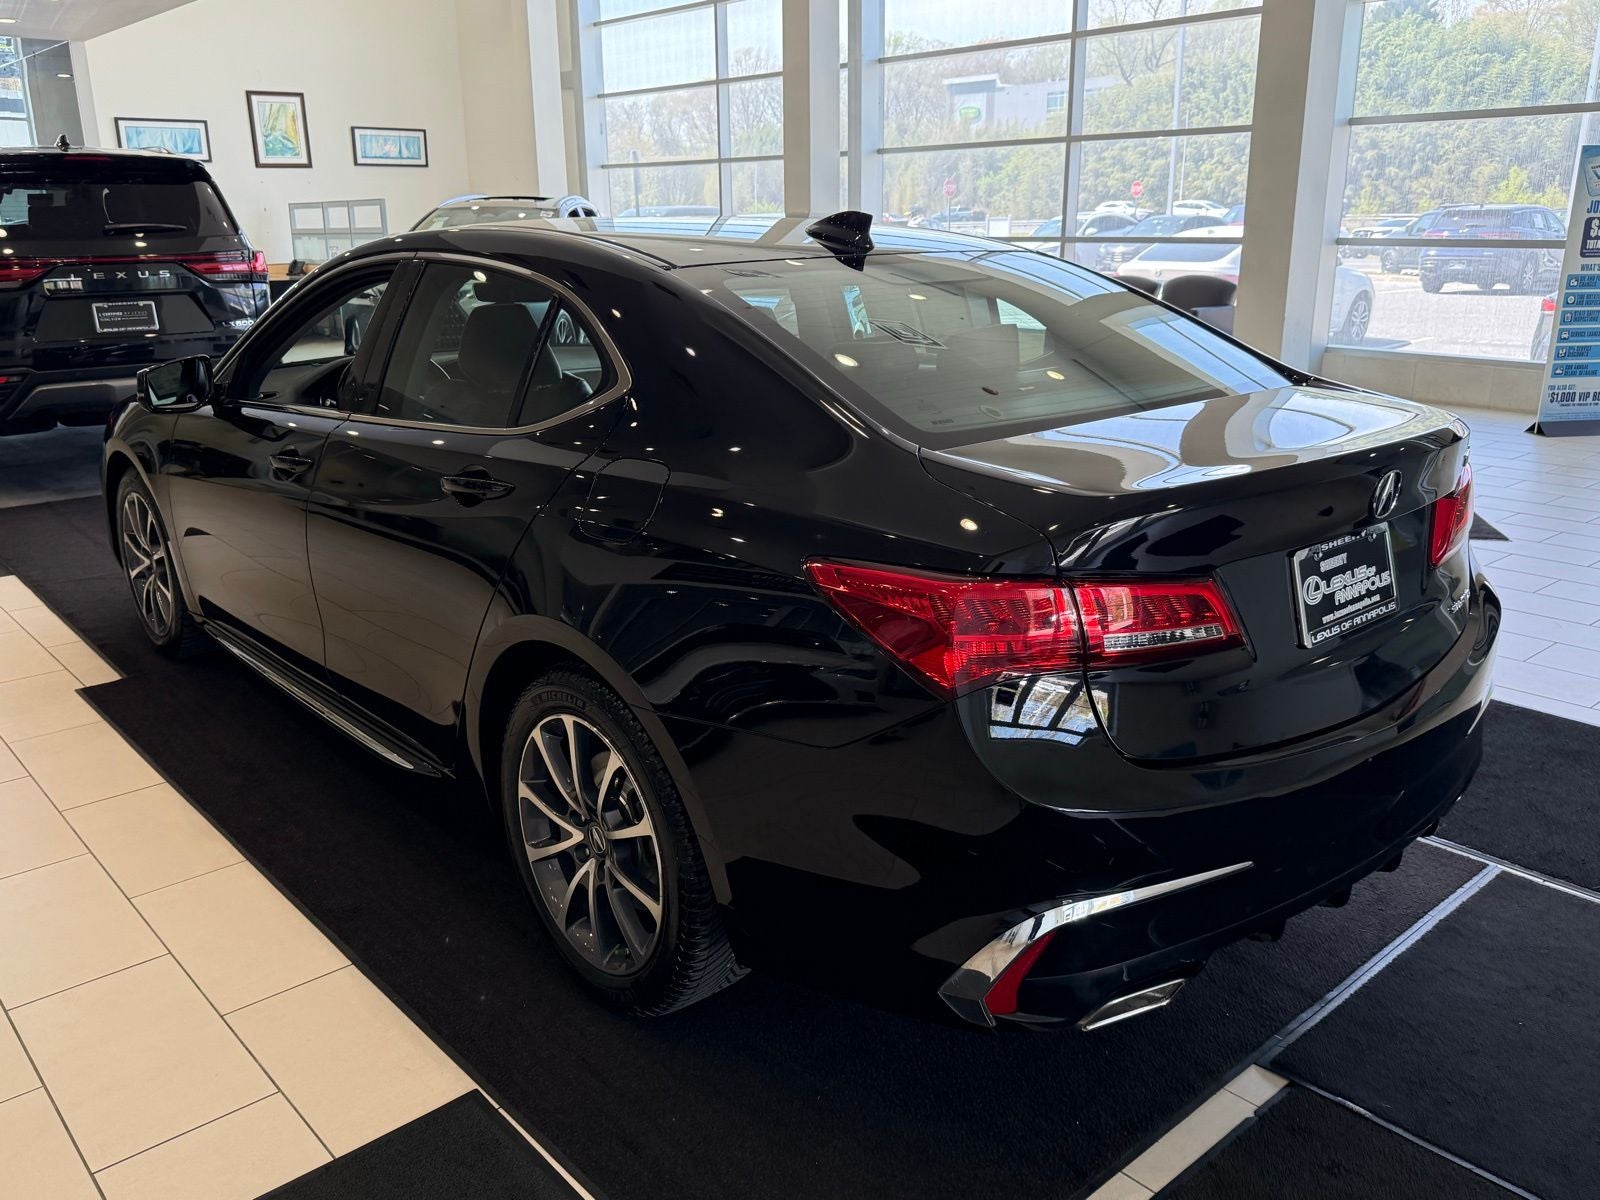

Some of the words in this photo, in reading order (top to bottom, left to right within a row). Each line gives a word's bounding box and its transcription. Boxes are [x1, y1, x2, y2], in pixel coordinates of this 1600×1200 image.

[69, 270, 170, 280] LEXUS
[1579, 391, 1591, 402] VIP
[1322, 564, 1368, 595] LEXUS
[1334, 570, 1392, 606] ANNAPOLIS
[1312, 625, 1340, 643] LEXUS
[1341, 619, 1353, 631] OF
[1353, 601, 1397, 626] ANNAPOLIS
